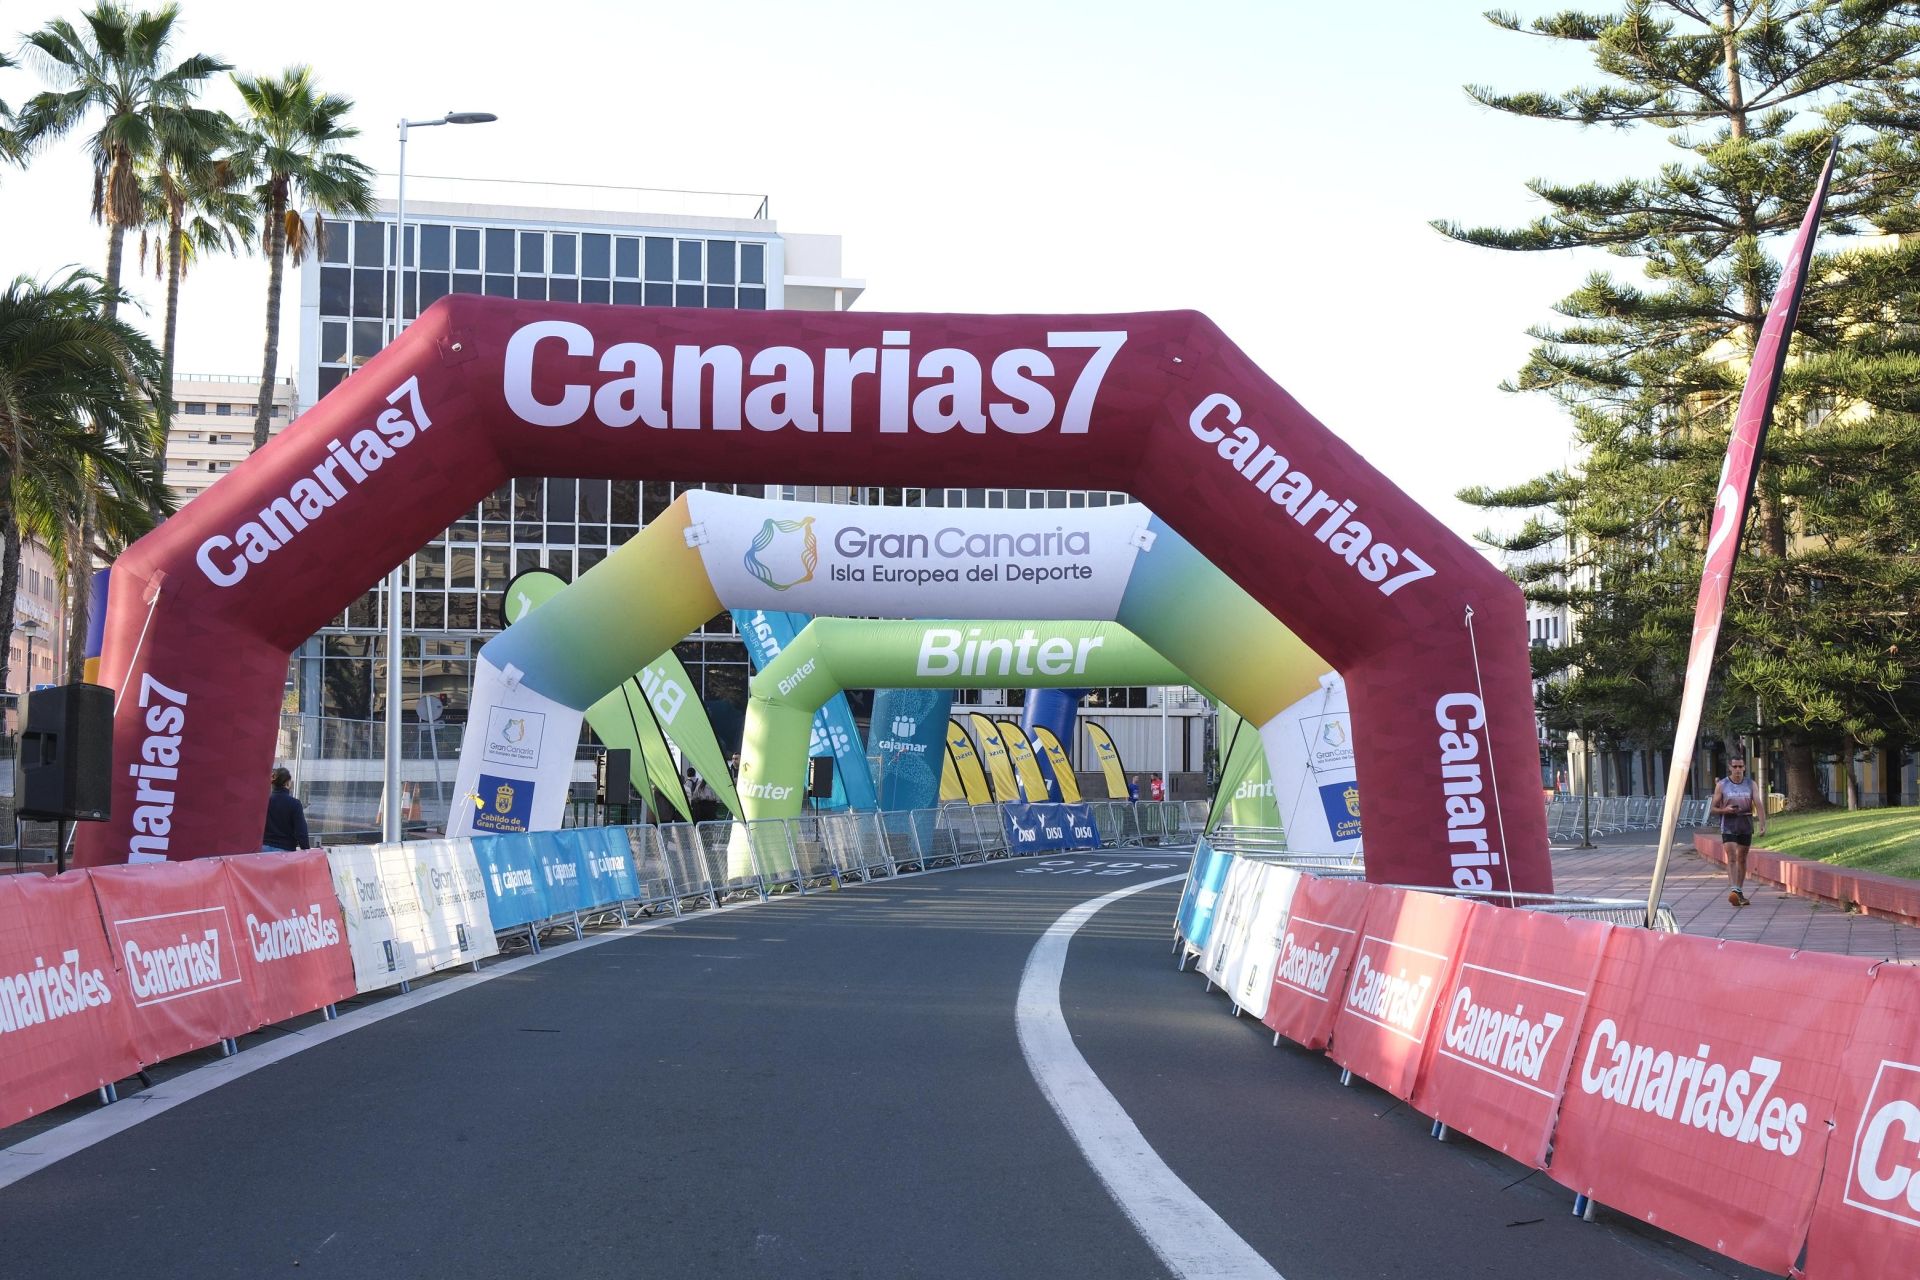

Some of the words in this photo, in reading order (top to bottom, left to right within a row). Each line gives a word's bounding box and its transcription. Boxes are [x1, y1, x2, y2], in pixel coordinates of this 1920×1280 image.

[503, 320, 1128, 436] Canarias7
[196, 375, 433, 588] Canarias7
[1189, 392, 1437, 597] Canarias7
[834, 526, 929, 559] Gran
[934, 526, 1091, 559] Canaria
[830, 563, 865, 582] Isla
[872, 564, 959, 587] Europea
[965, 563, 998, 582] del
[1006, 563, 1093, 585] Deporte
[777, 657, 817, 696] Binter
[916, 628, 1105, 677] Binter
[127, 672, 188, 865] narias7
[878, 738, 928, 753] cajamar
[476, 820, 498, 829] Gran
[495, 821, 526, 833] Canaria
[480, 812, 510, 824] Cabildo
[510, 816, 521, 825] de
[1336, 828, 1356, 837] Gran
[502, 864, 533, 895] cajamar
[246, 904, 340, 963] Canarias7.es
[125, 929, 222, 999] Canarias7
[1350, 954, 1433, 1031] Canarias7
[1444, 986, 1565, 1082] Canarias7
[1581, 1018, 1808, 1157] Canarias7.es
